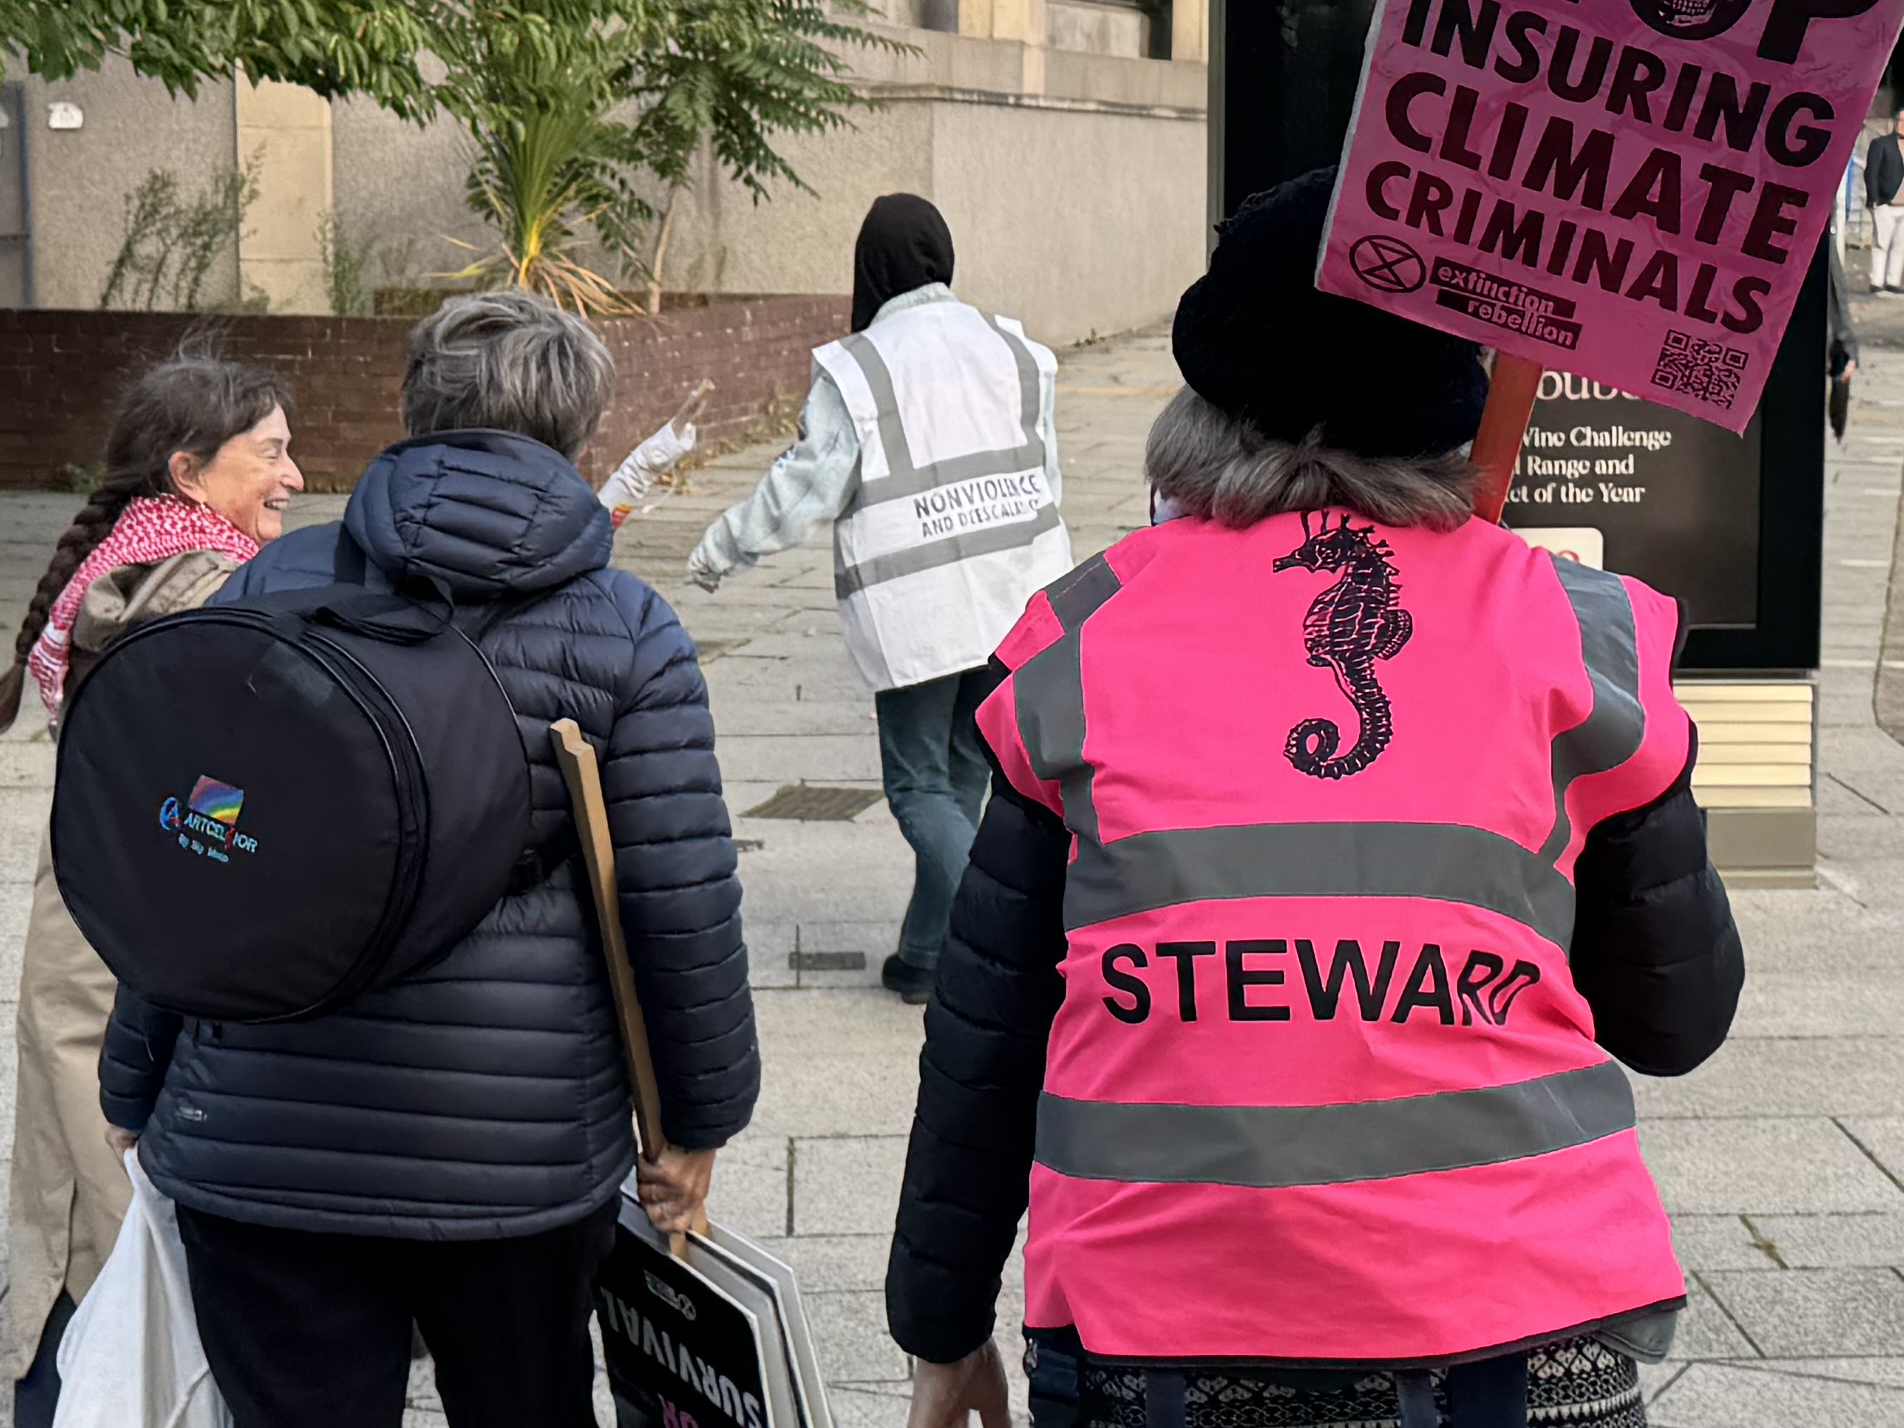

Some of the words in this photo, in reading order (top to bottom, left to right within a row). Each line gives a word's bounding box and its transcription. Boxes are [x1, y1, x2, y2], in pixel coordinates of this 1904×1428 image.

[1385, 71, 1809, 266] CLIMATE
[1365, 160, 1772, 335] CRIMINALS
[1437, 266, 1555, 315] extinction
[1467, 300, 1574, 346] rebellion
[1569, 425, 1673, 451] Challenge
[1527, 455, 1591, 479] Range
[1594, 453, 1635, 476] and
[1534, 481, 1557, 504] of
[1560, 481, 1594, 504] the
[1598, 482, 1647, 504] Year
[921, 515, 954, 539] AND
[1100, 938, 1542, 1027] STEWARD
